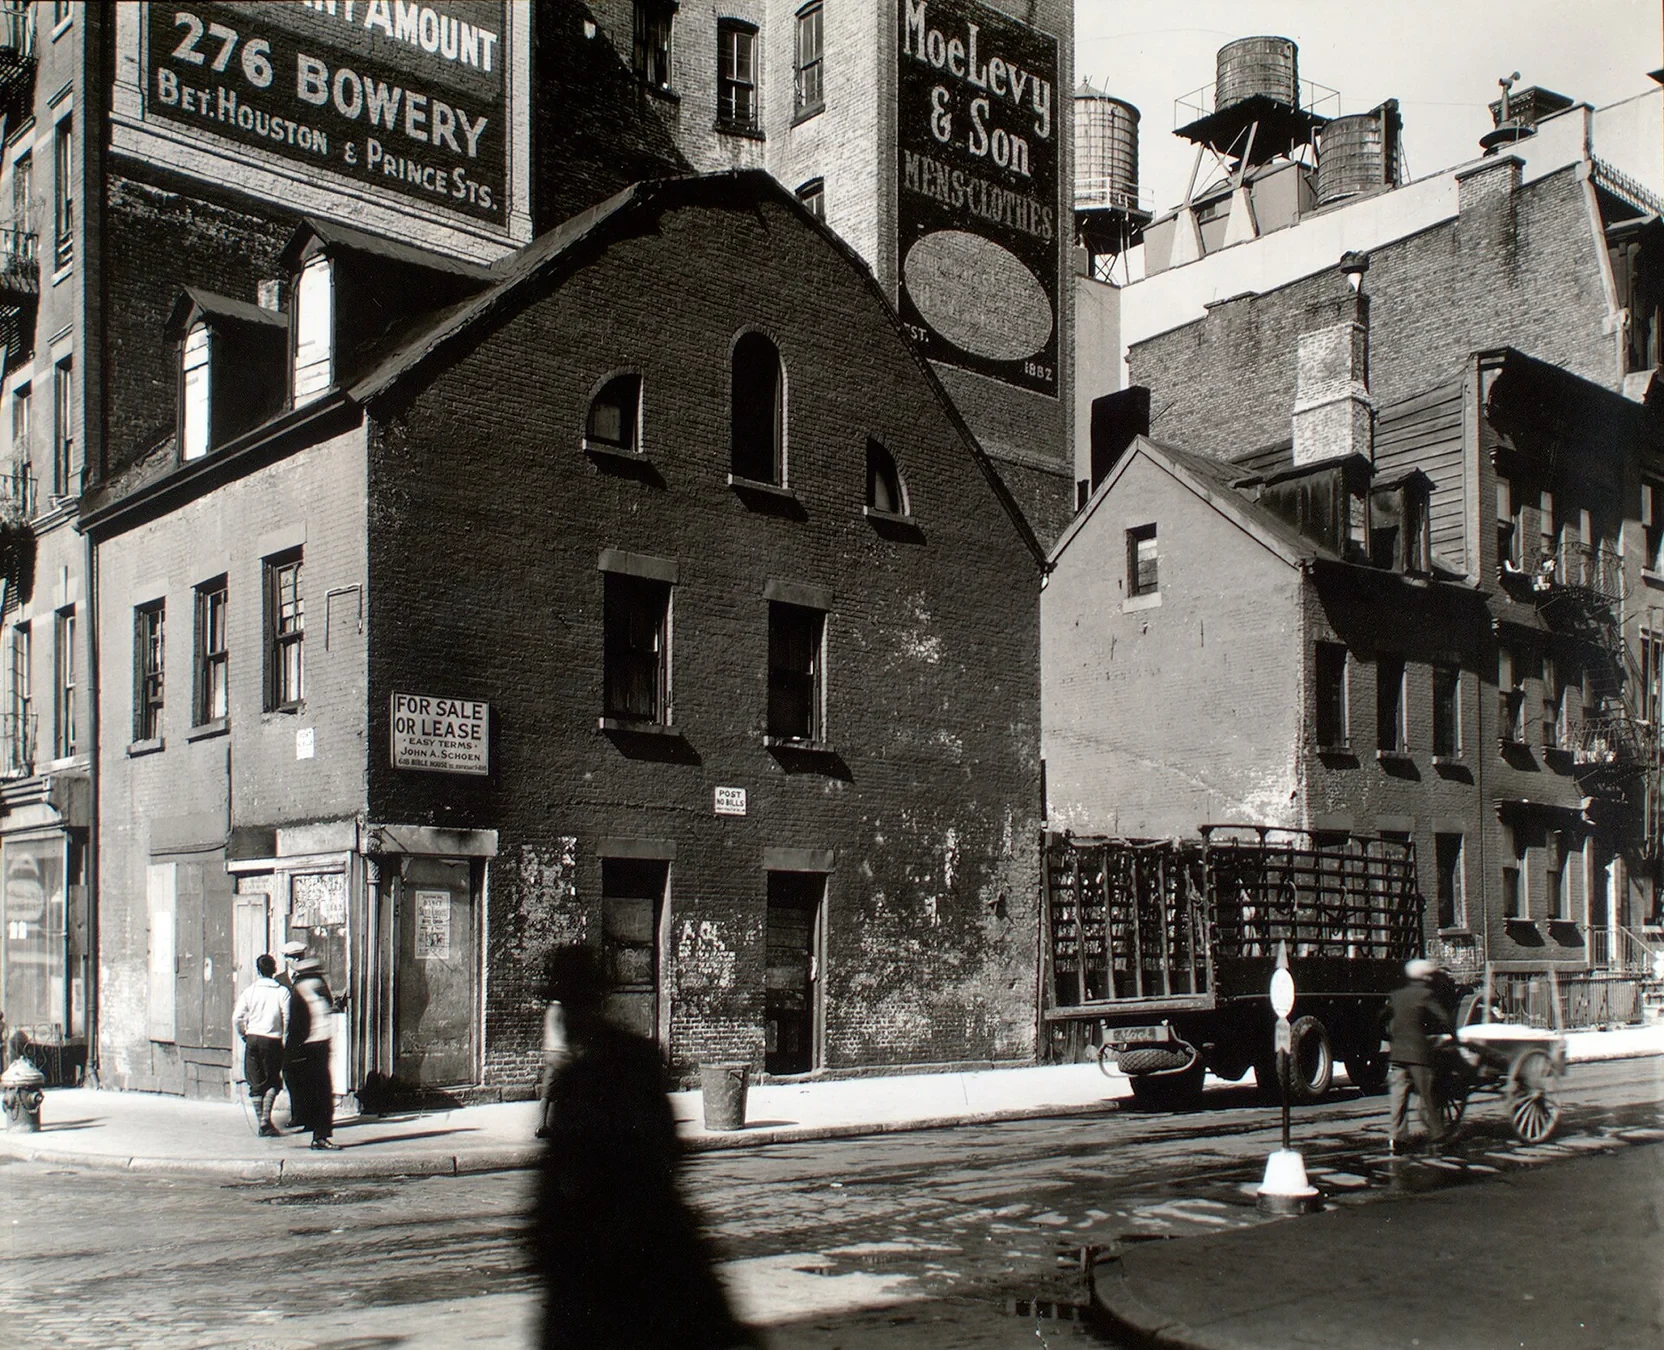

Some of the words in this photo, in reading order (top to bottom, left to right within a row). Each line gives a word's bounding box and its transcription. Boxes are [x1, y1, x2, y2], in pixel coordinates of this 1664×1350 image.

[364, 0, 497, 72] AMOUNT
[171, 12, 275, 88] 276
[297, 53, 489, 157] BOWERY
[216, 86, 328, 155] HOUSTON
[343, 141, 358, 165] &
[367, 137, 448, 196] PRINCE
[931, 85, 952, 143] &
[969, 97, 1031, 177] Son
[966, 178, 1053, 239] CLOTHES
[904, 322, 929, 342] ST.
[1024, 362, 1053, 381] 1882
[396, 717, 416, 735] OR
[422, 719, 482, 740] LEASE
[397, 696, 431, 716] FOR
[436, 700, 483, 720] SALE
[400, 747, 427, 757] JOHN
[430, 750, 440, 758] A.
[441, 749, 481, 761] SCHOEN
[409, 737, 436, 747] EASY
[438, 740, 473, 750] TERMS
